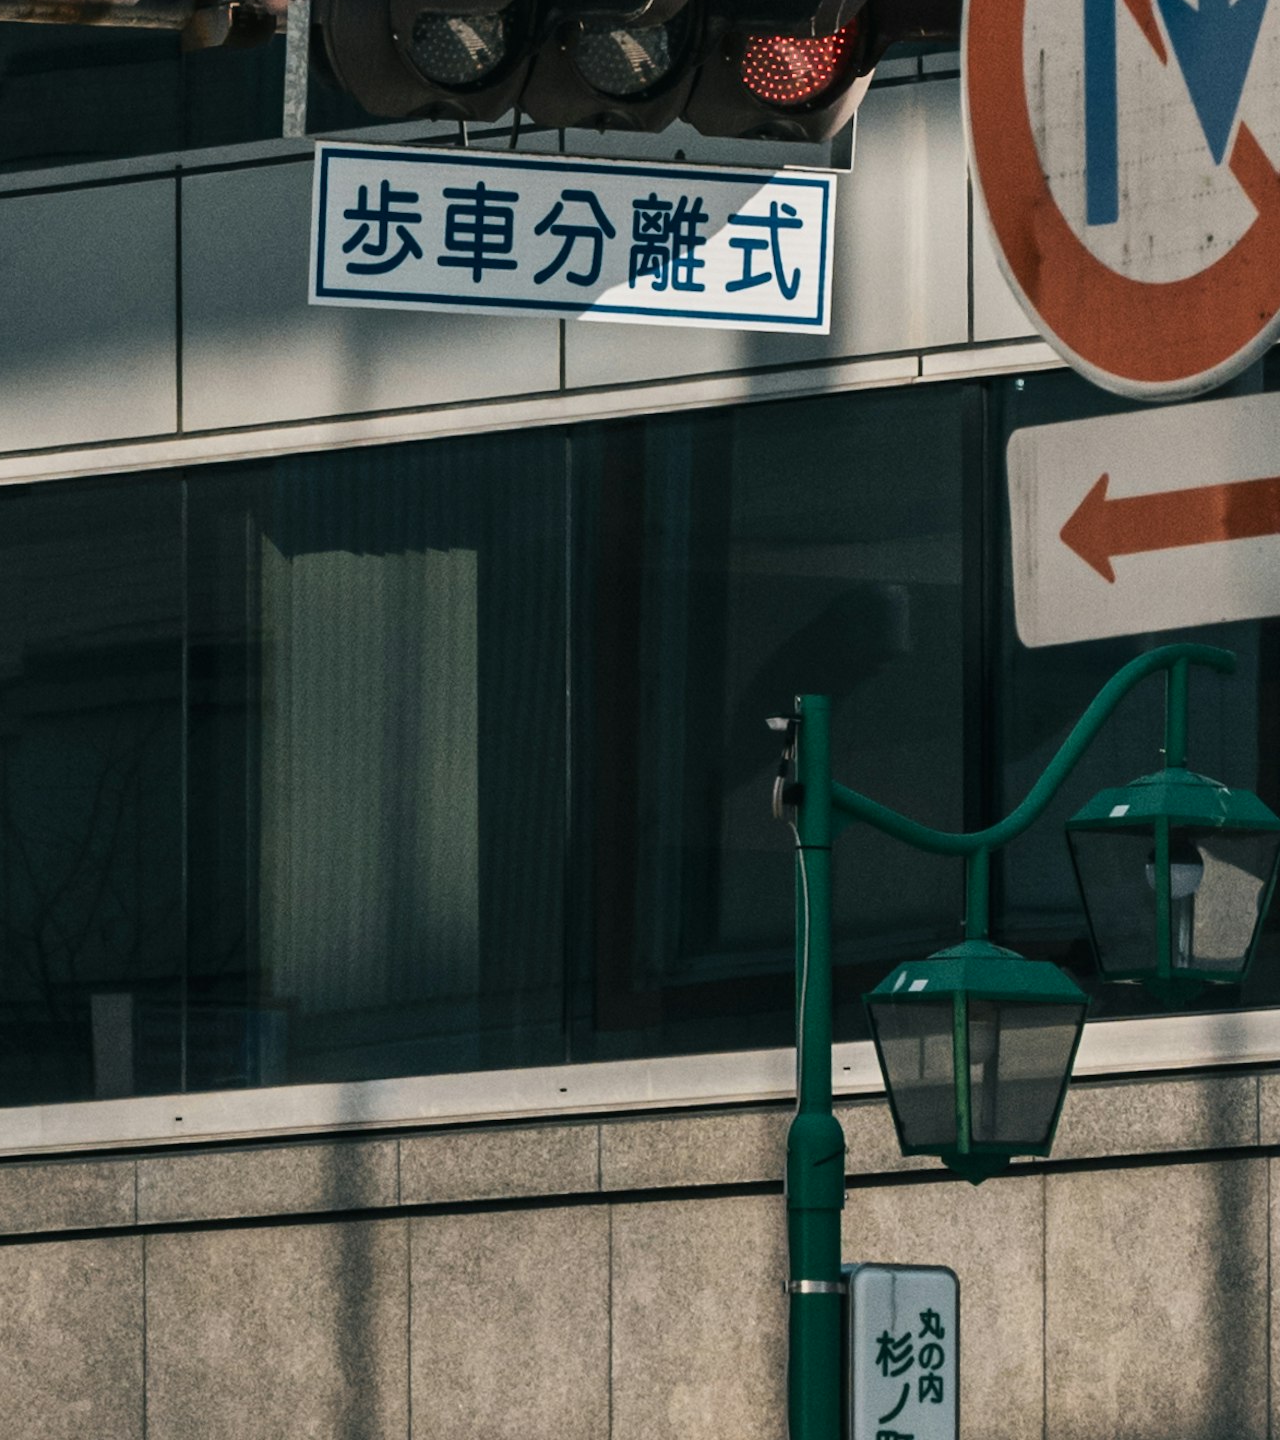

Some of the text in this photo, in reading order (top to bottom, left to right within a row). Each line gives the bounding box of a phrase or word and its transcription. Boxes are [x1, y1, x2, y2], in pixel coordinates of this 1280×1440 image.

[342, 179, 803, 300] 歩車分離式
[918, 1308, 945, 1404] 丸の内
